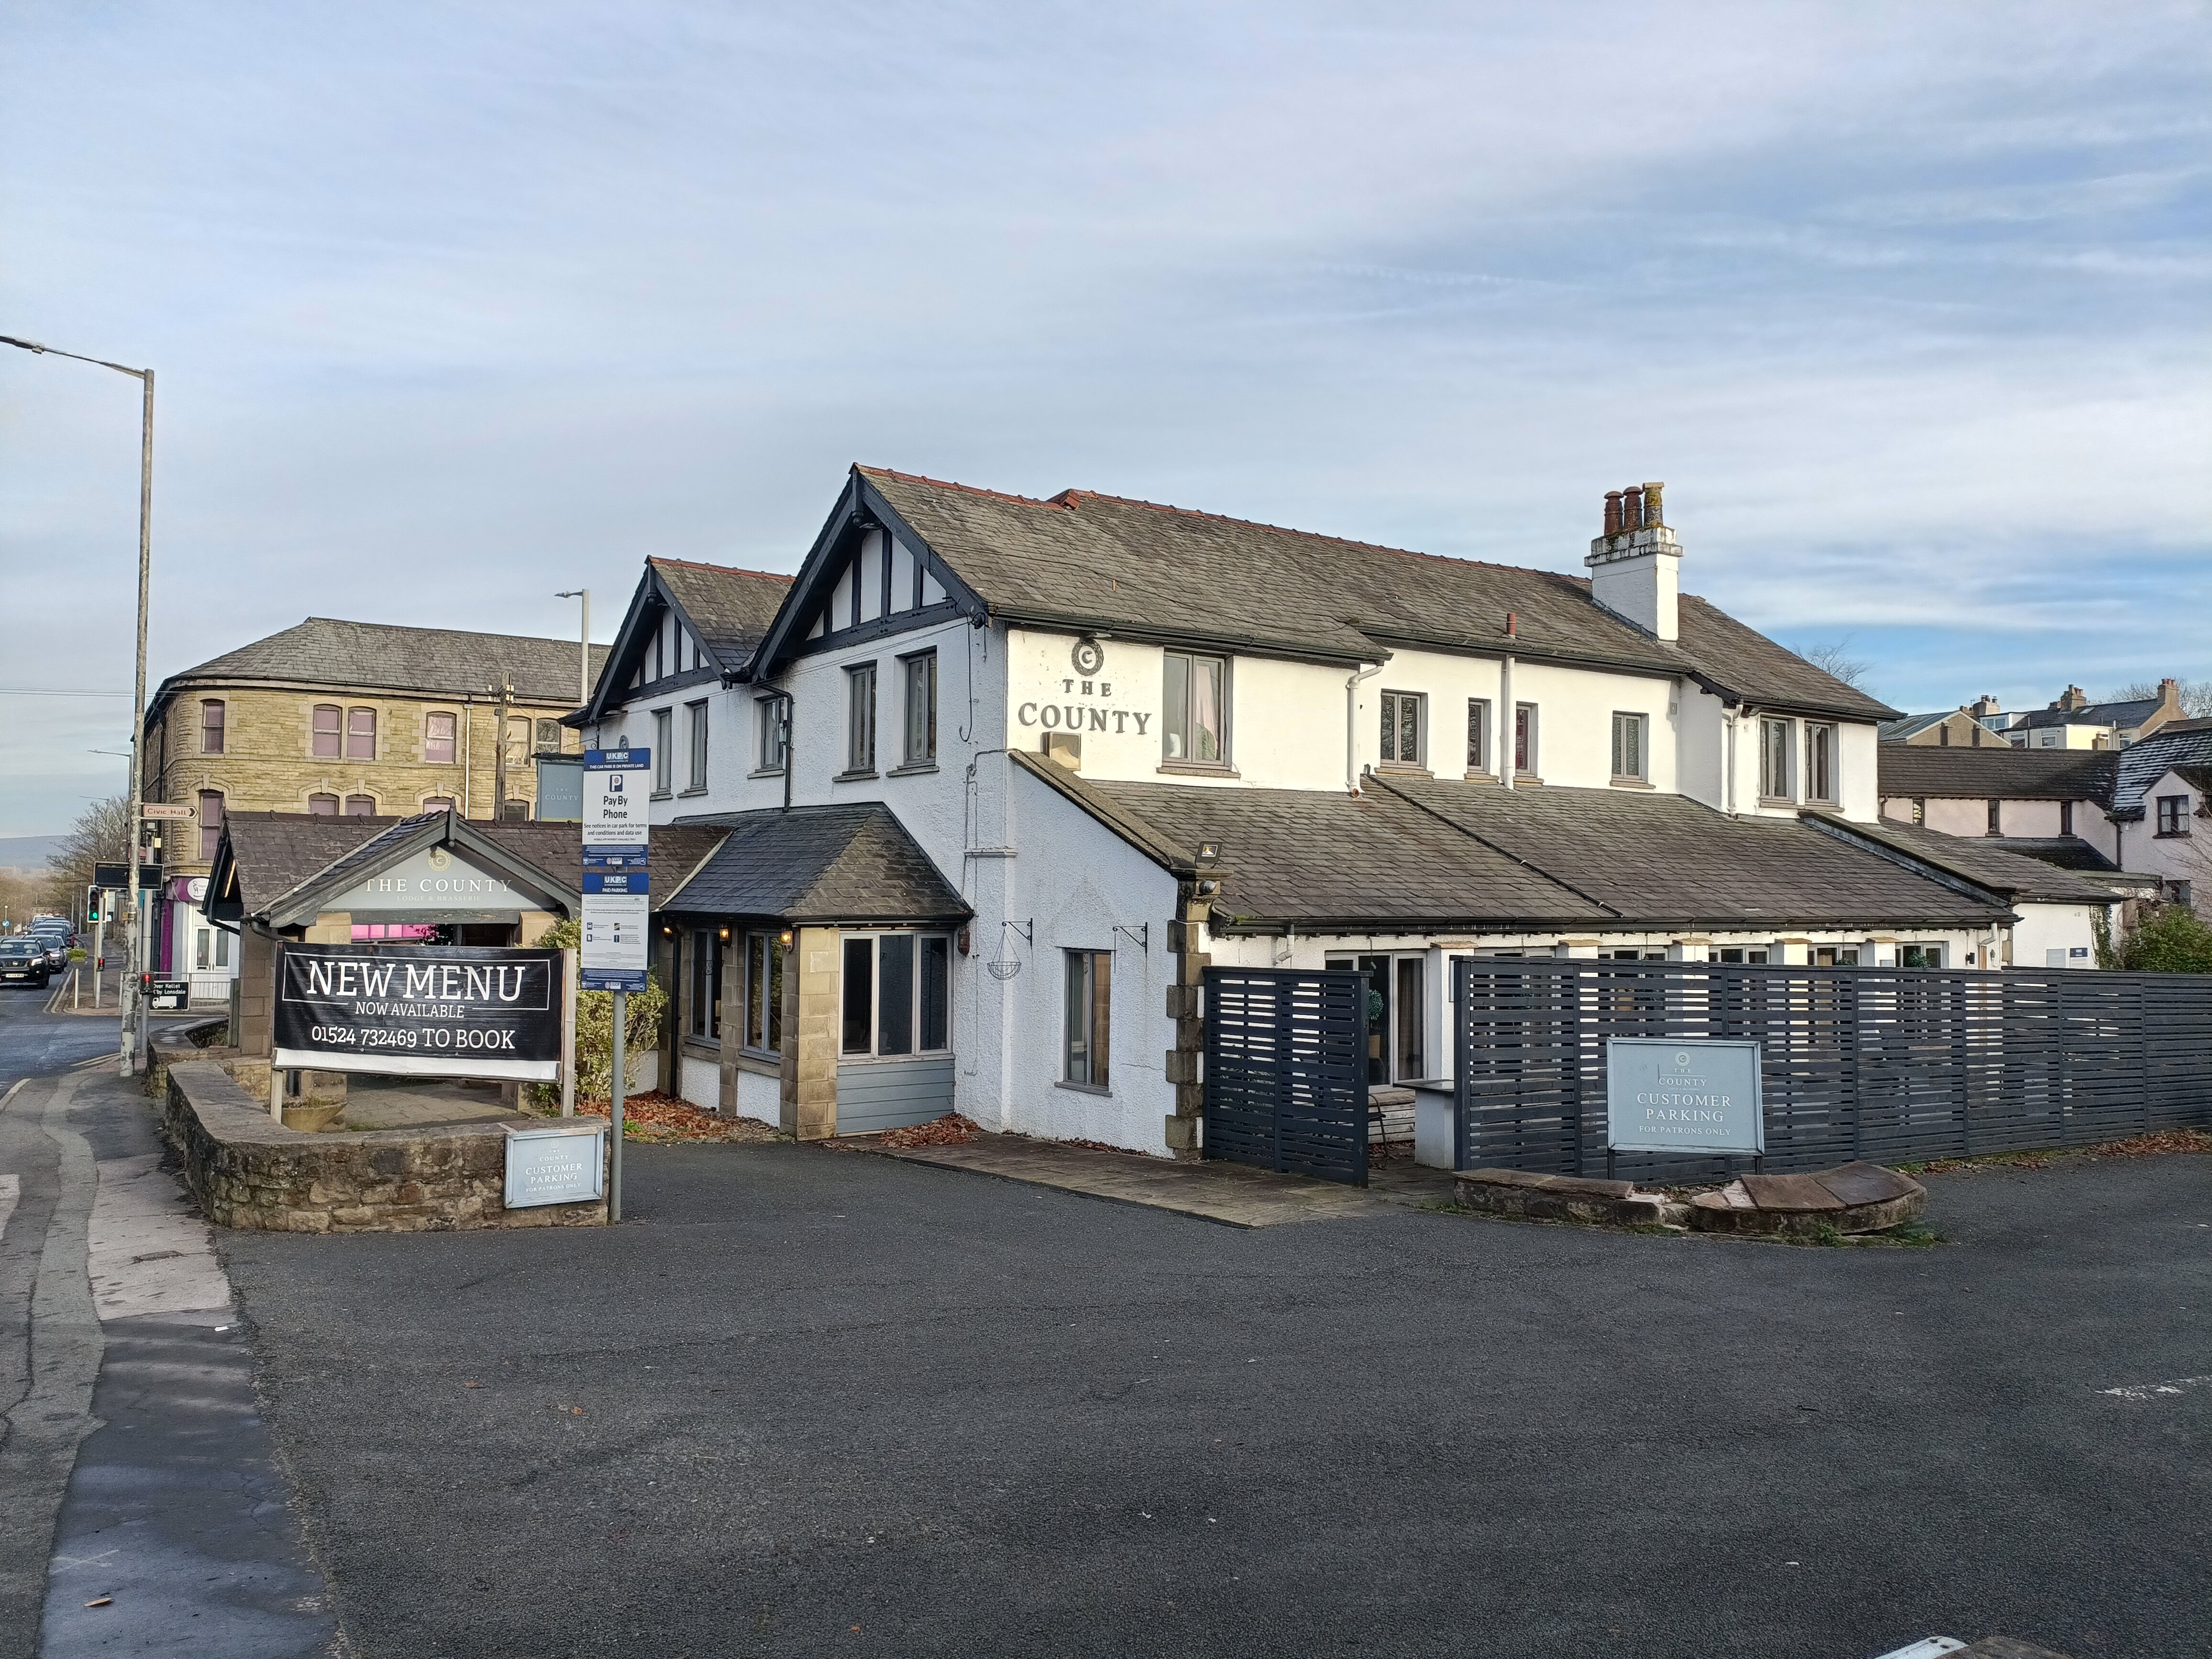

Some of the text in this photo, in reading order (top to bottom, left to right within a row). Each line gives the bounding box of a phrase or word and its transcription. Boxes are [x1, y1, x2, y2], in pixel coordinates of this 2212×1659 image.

[1082, 650, 1093, 664] C
[1062, 679, 1112, 697] THE
[1018, 702, 1152, 735] COUNTY
[604, 796, 628, 807] Pay By
[603, 809, 628, 818] Phone
[365, 878, 512, 892] THE COUNTY
[306, 960, 525, 1001] NEW MENU
[355, 1001, 465, 1018] NOW AVAILABLE
[311, 1025, 515, 1049] 01524 732469 TO BOOK
[1659, 1078, 1707, 1086] COUNTY
[1637, 1093, 1732, 1107] CUSTOMER
[1646, 1108, 1724, 1122] PARKING
[1660, 1127, 1703, 1135] PATRONS
[526, 1163, 582, 1175] CUSTOMER
[531, 1172, 577, 1184] PARKING
